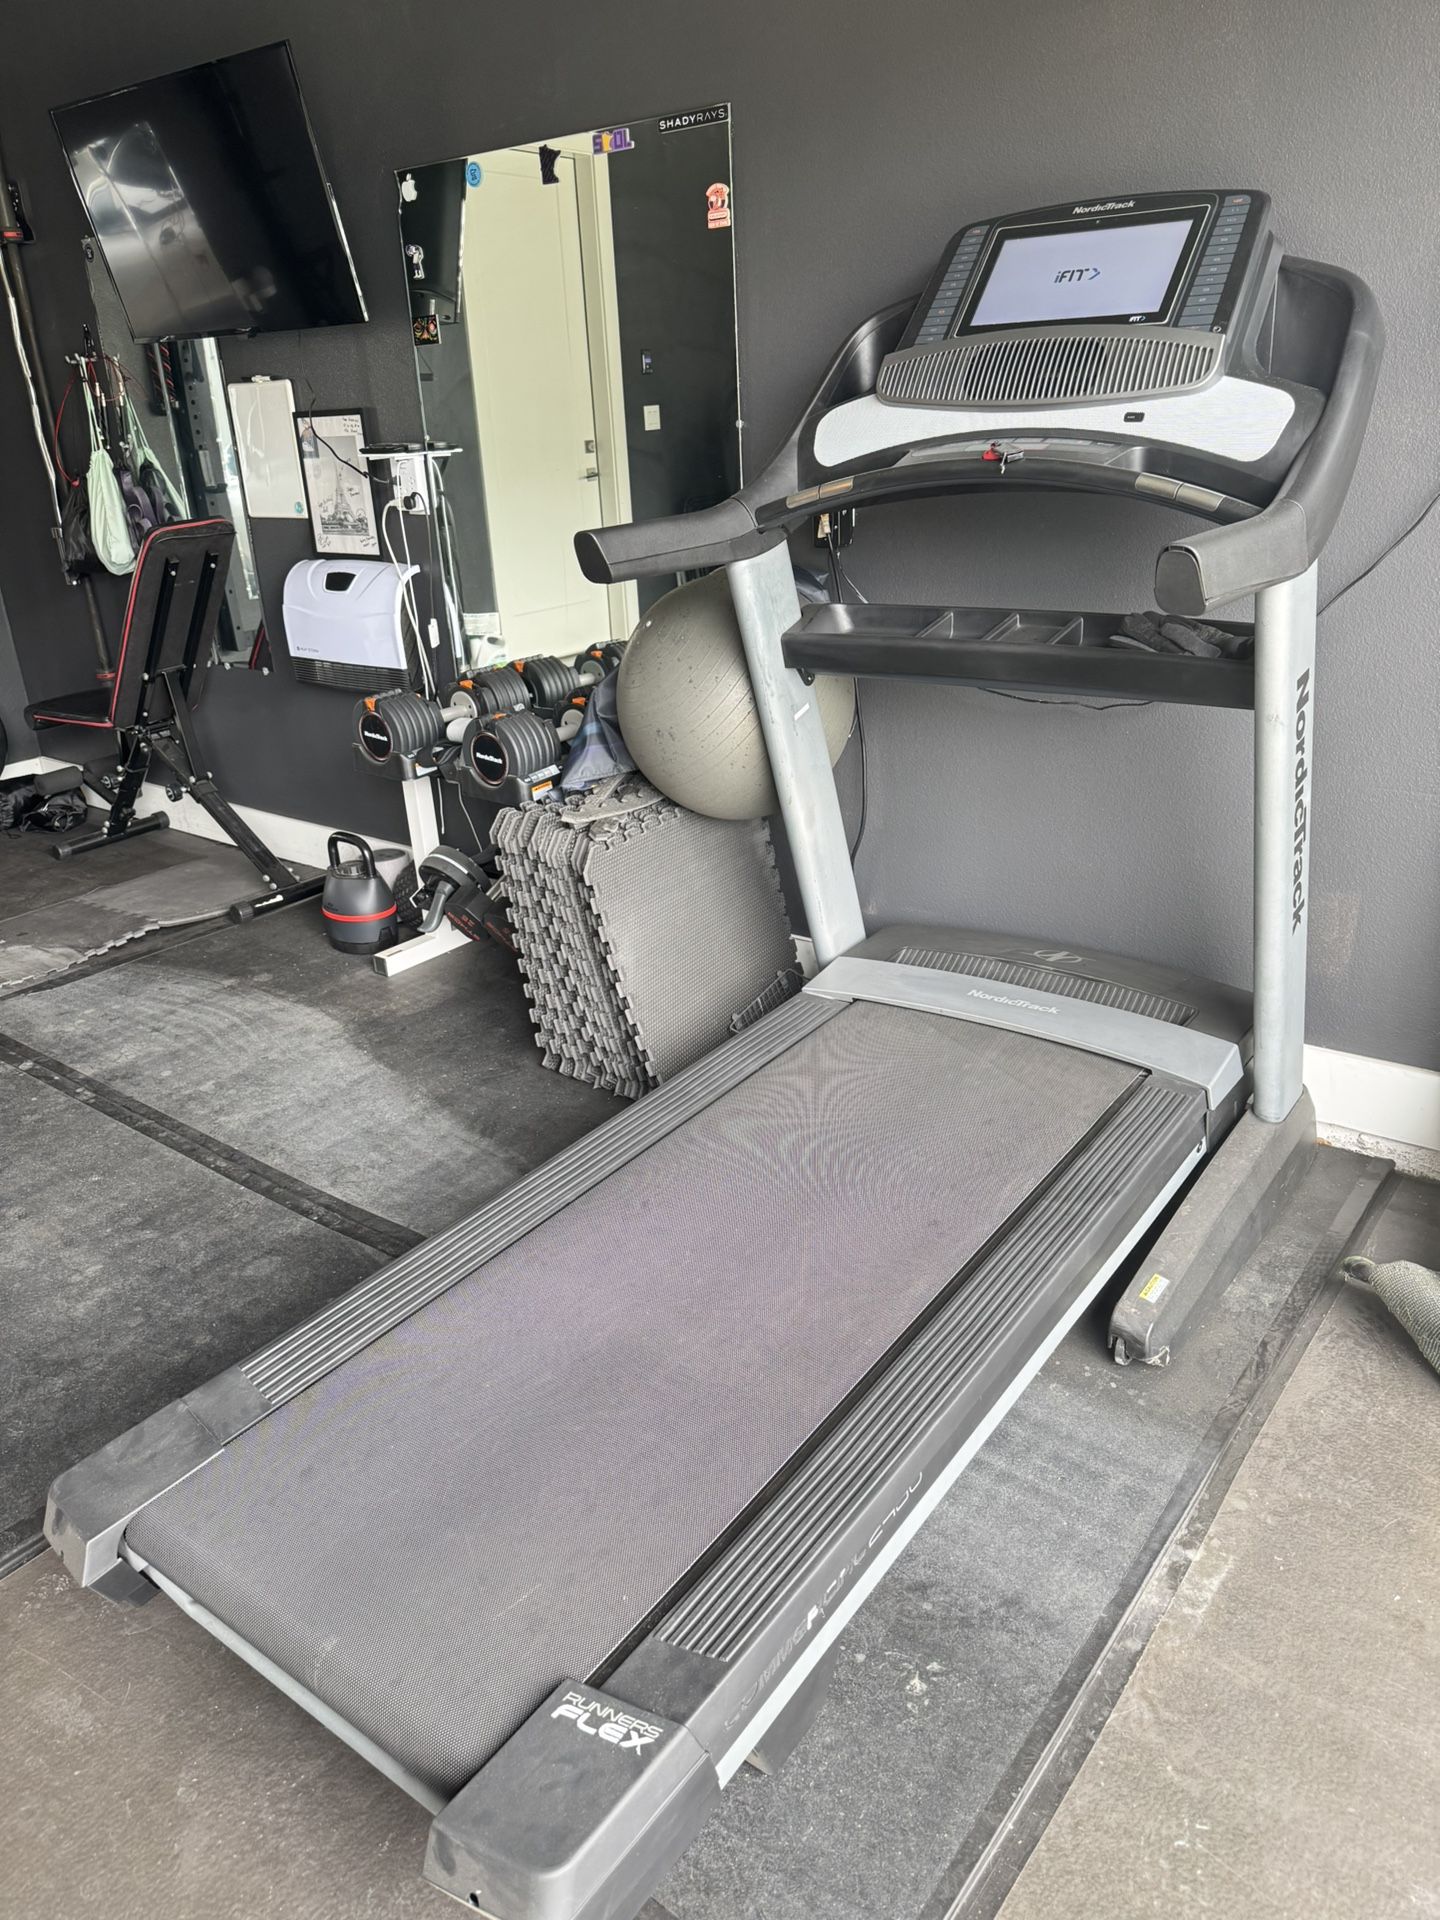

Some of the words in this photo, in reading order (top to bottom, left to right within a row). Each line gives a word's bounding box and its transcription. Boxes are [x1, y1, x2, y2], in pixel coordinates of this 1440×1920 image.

[659, 109, 725, 130] SHADYRAYS
[1072, 200, 1136, 215] NordicTrack
[1054, 267, 1089, 283] iFIT
[1292, 668, 1310, 936] NordicTrack
[967, 989, 1061, 1015] NordicTrack
[562, 1691, 664, 1738] RUNNERS
[550, 1704, 655, 1756] FLEX
